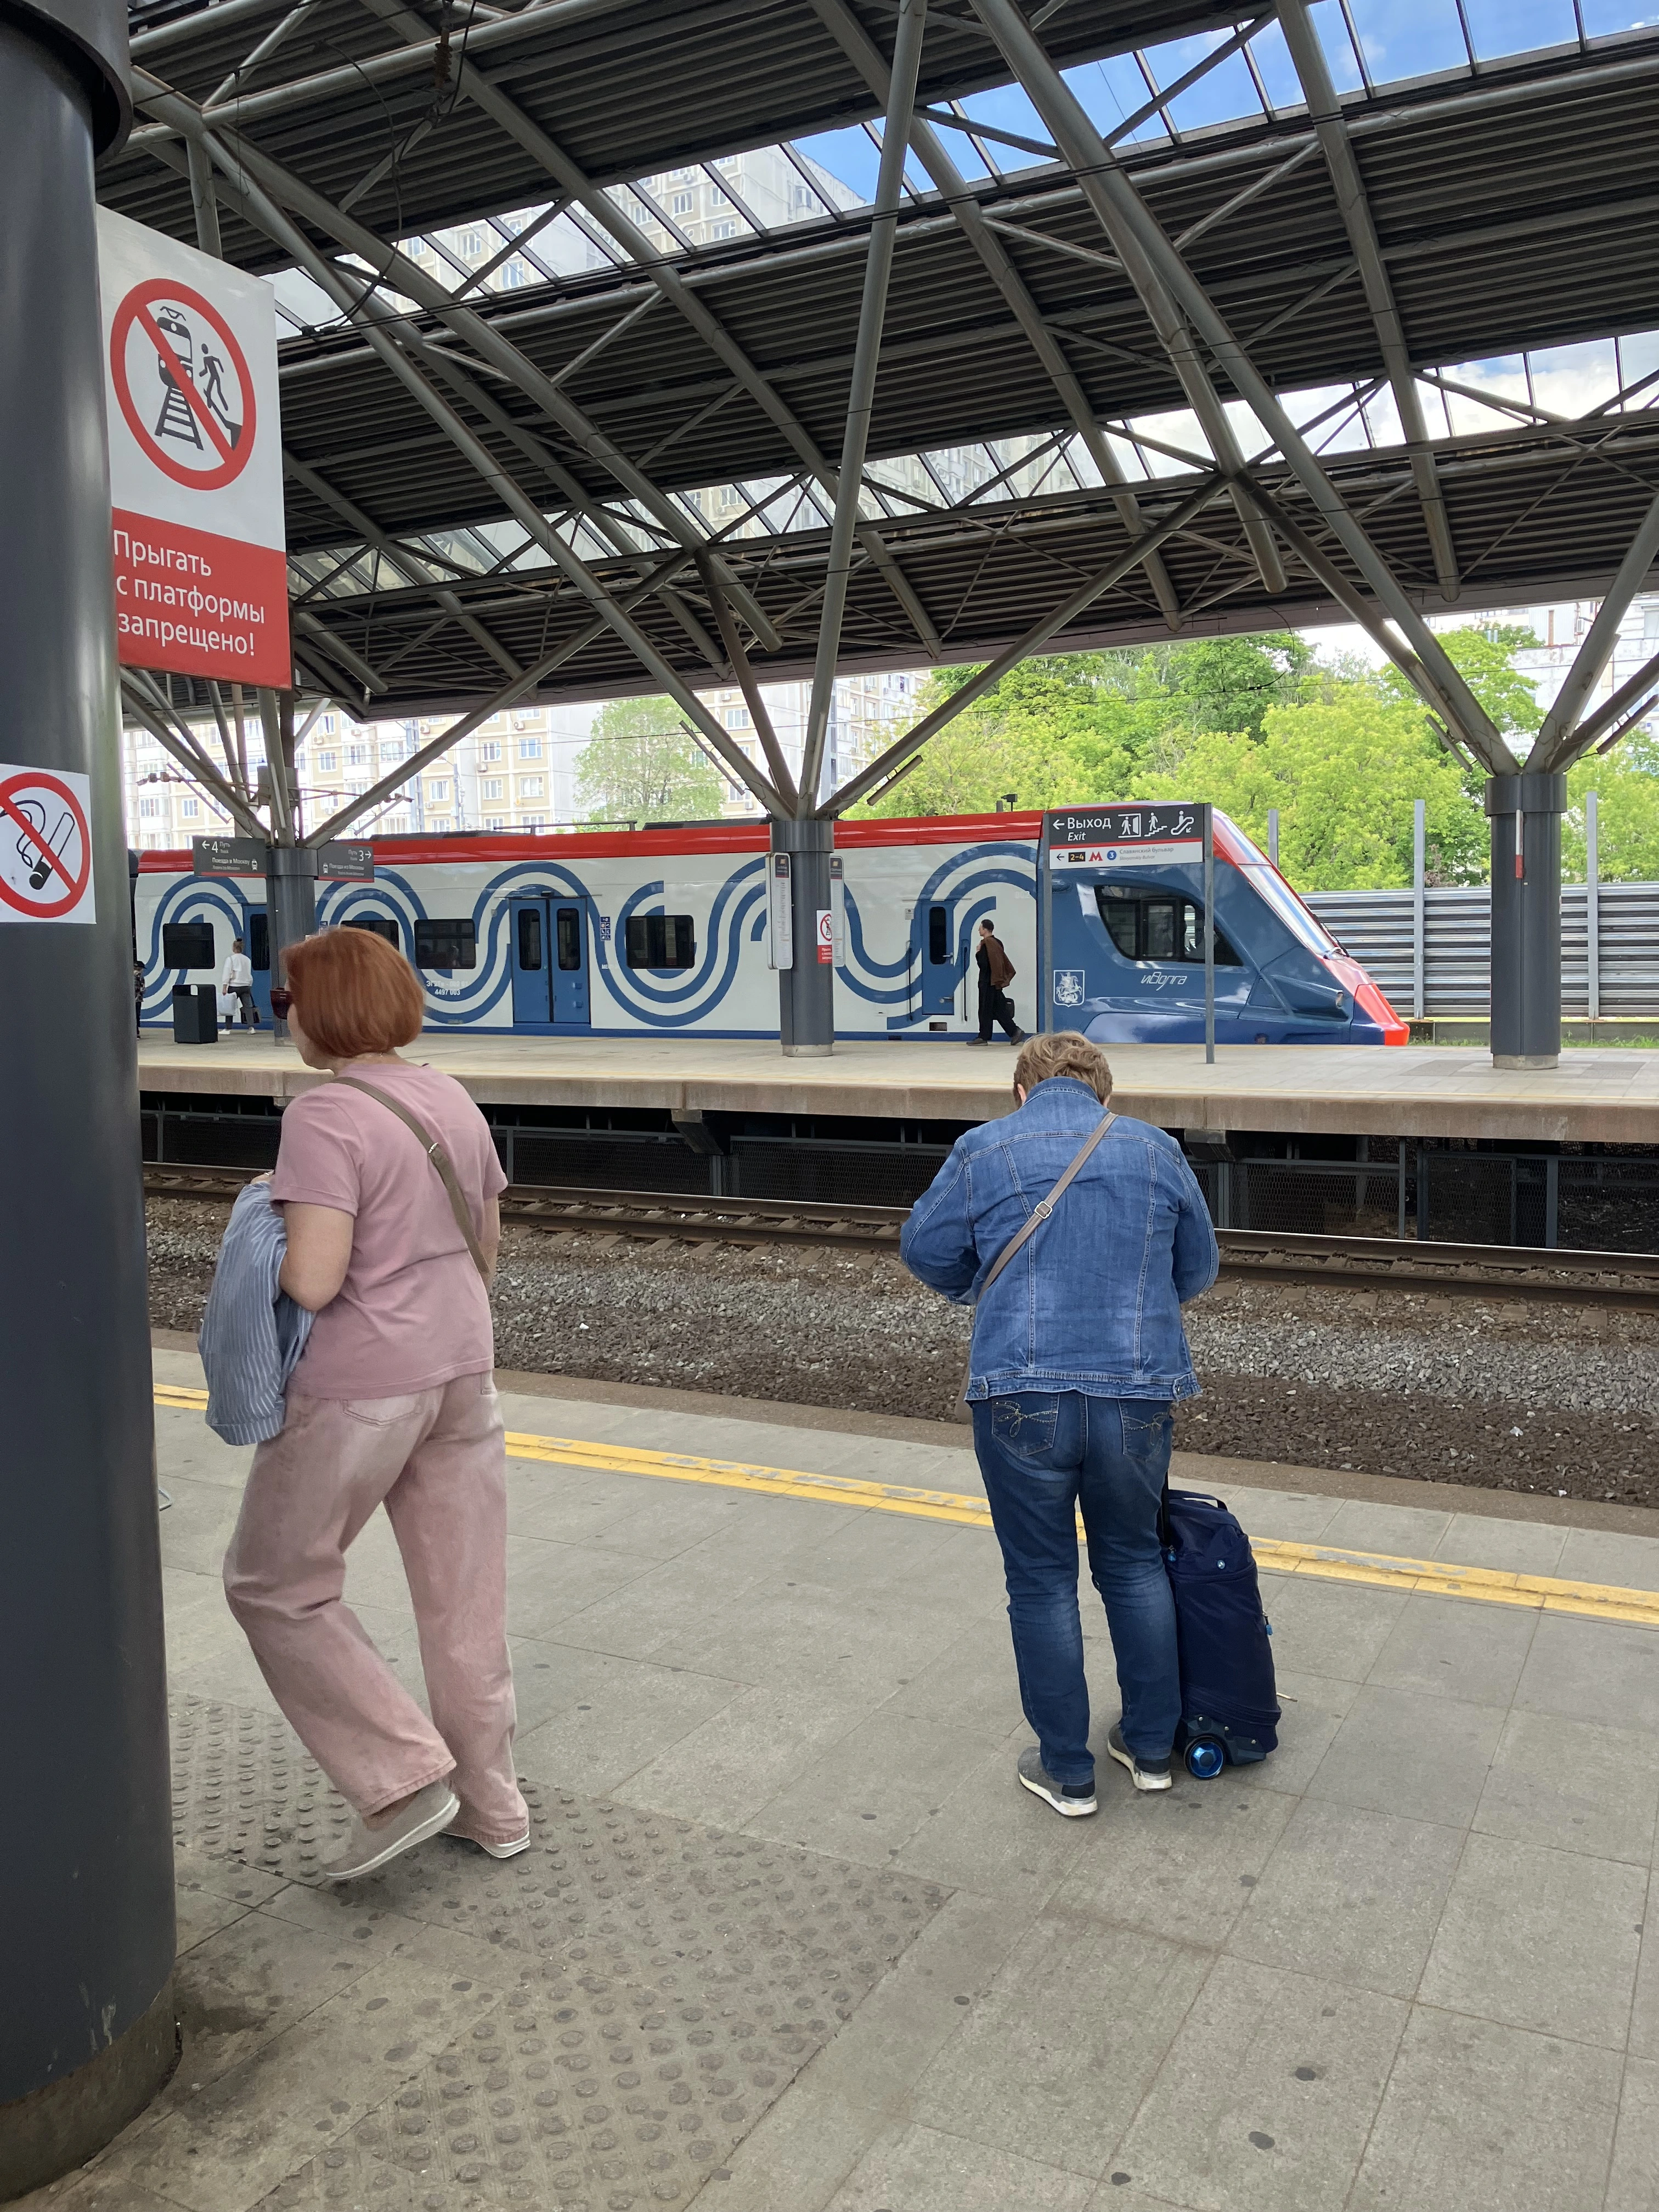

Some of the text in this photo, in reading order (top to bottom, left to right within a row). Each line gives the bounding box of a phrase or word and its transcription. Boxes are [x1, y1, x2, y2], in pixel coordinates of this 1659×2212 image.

[114, 529, 211, 577] Прыгать
[116, 575, 264, 623] с платформы
[119, 613, 255, 656] запрещено!
[1067, 817, 1111, 830] Выход
[1068, 832, 1086, 841] Exit
[211, 841, 218, 854] 4
[358, 850, 364, 862] 3
